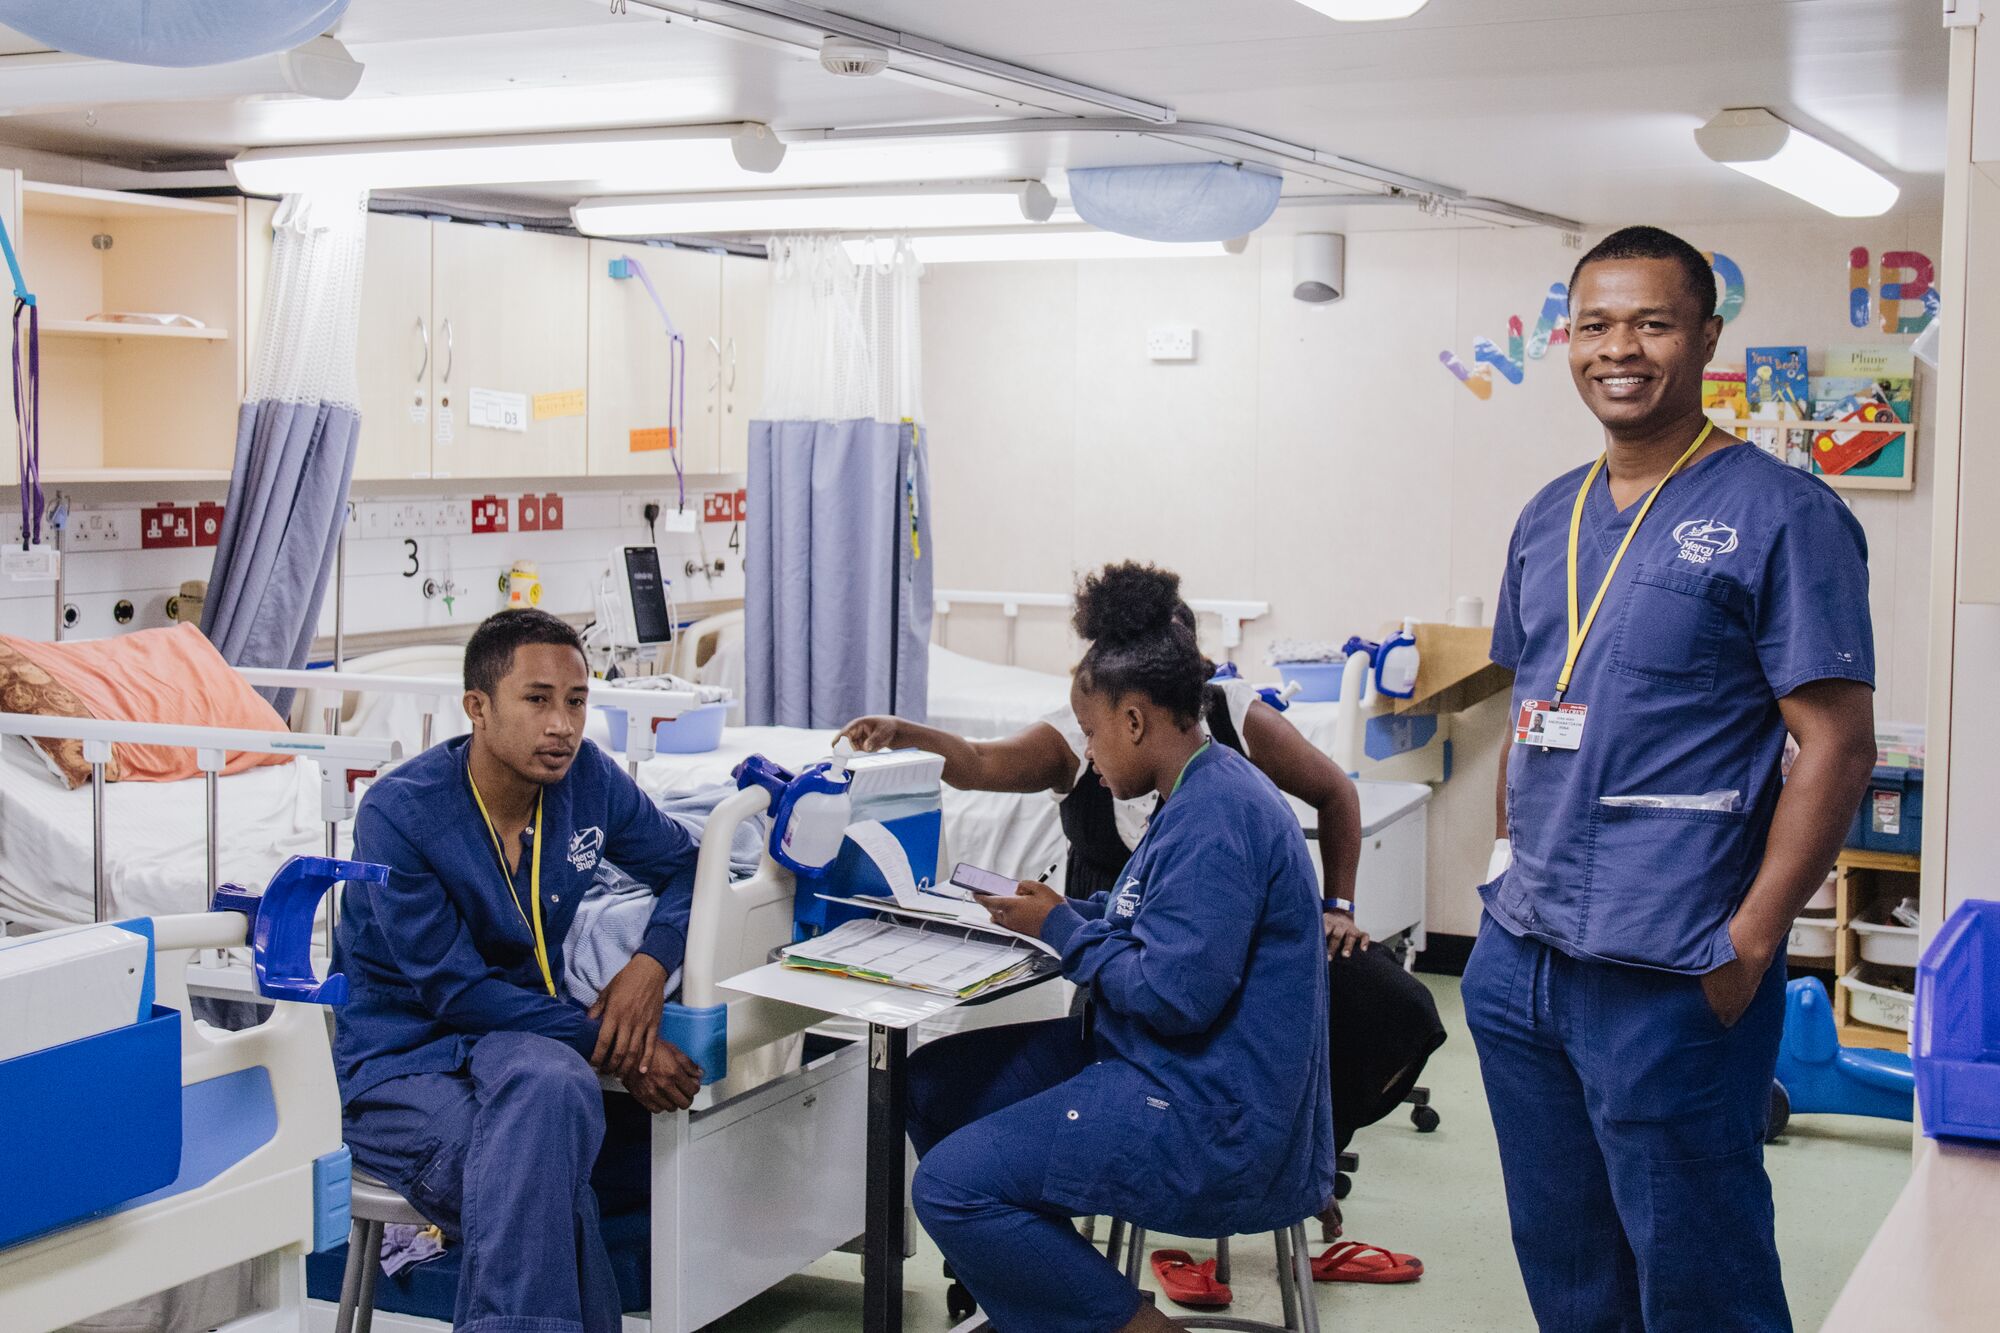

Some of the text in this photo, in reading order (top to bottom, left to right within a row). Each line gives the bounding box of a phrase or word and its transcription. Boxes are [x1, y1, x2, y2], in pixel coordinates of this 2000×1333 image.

[504, 412, 517, 425] D3
[729, 522, 740, 555] 4
[1678, 550, 1707, 564] Ships
[1681, 540, 1714, 557] Mercy
[402, 538, 419, 577] 3
